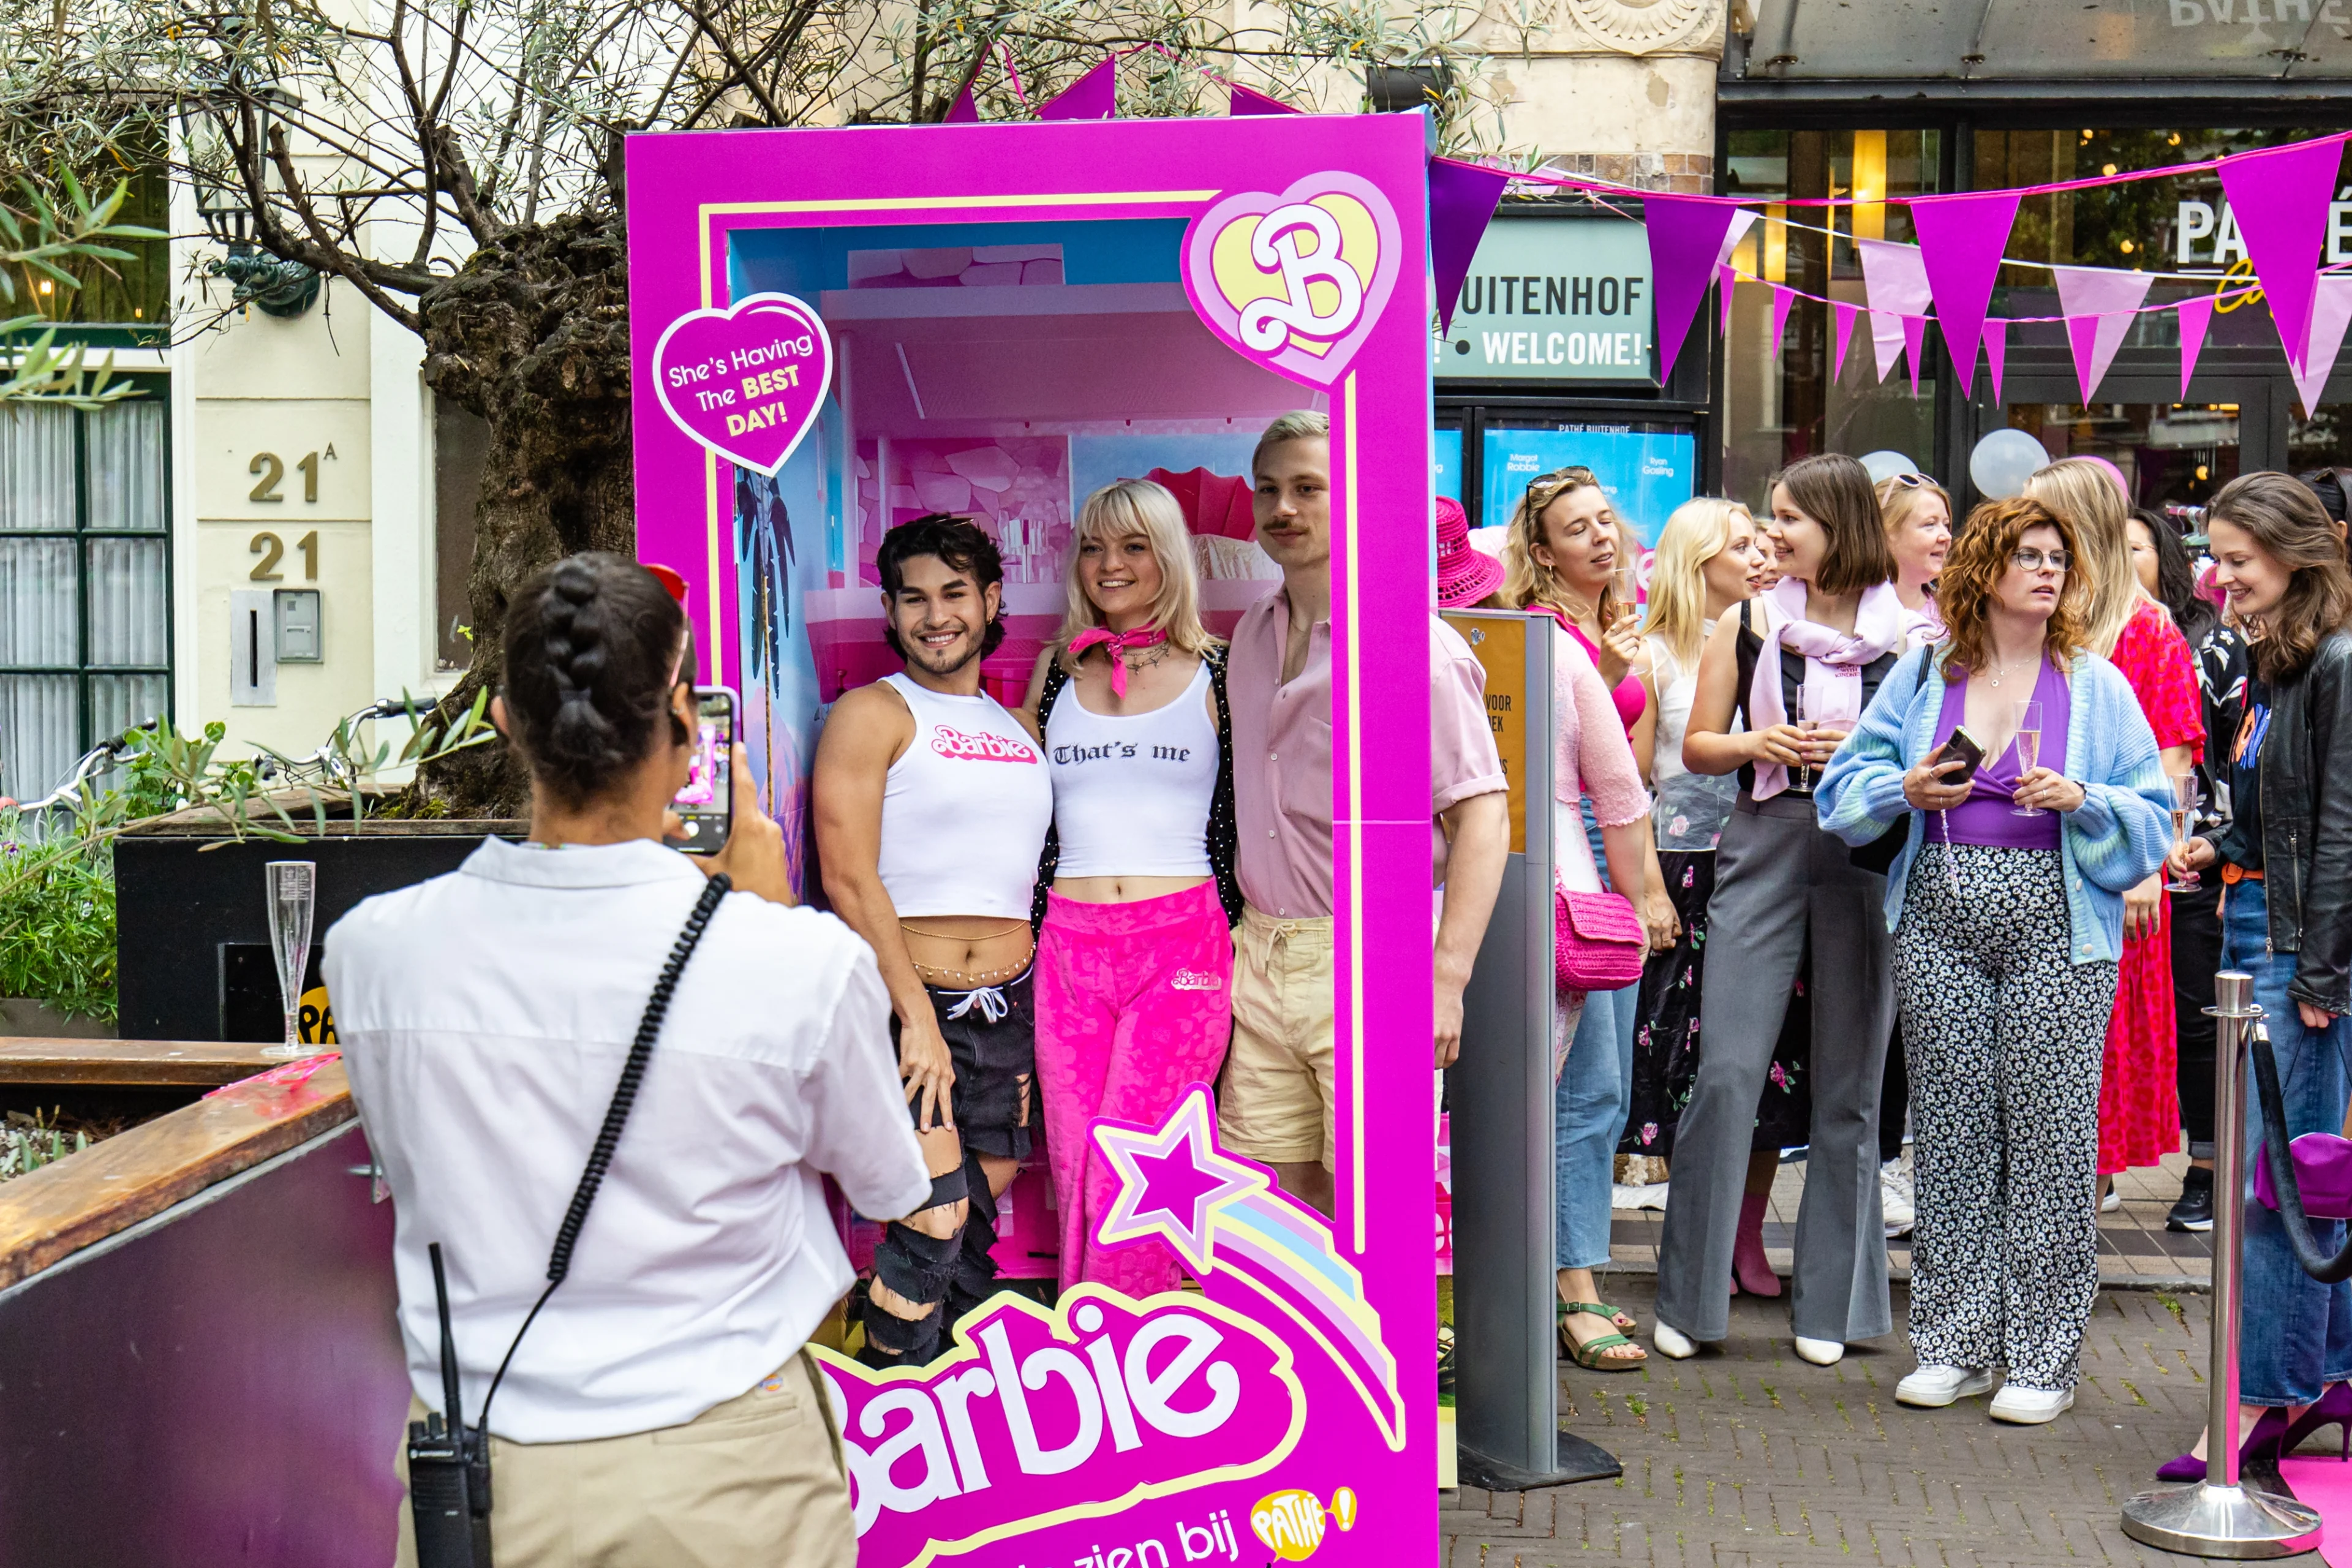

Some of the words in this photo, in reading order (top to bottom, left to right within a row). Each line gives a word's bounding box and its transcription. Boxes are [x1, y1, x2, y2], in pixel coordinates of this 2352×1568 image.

[2177, 186, 2352, 263] PAÉ
[1238, 203, 1363, 352] B
[1461, 276, 1644, 316] UITENHOF
[669, 357, 728, 387] She's
[731, 335, 813, 371] Having
[1482, 331, 1642, 365] WELCOME!
[695, 388, 736, 412] The
[741, 364, 799, 399] BEST
[726, 401, 788, 437] DAY!
[249, 451, 318, 503] 21
[1507, 462, 1540, 472] Robbie
[1643, 466, 1674, 478] Gosling
[249, 530, 318, 581] 21
[1485, 694, 1511, 711] VOOR
[932, 725, 1035, 763] Barbie
[1053, 742, 1137, 765] That's
[1152, 744, 1191, 762] me
[1176, 1509, 1239, 1562] bij
